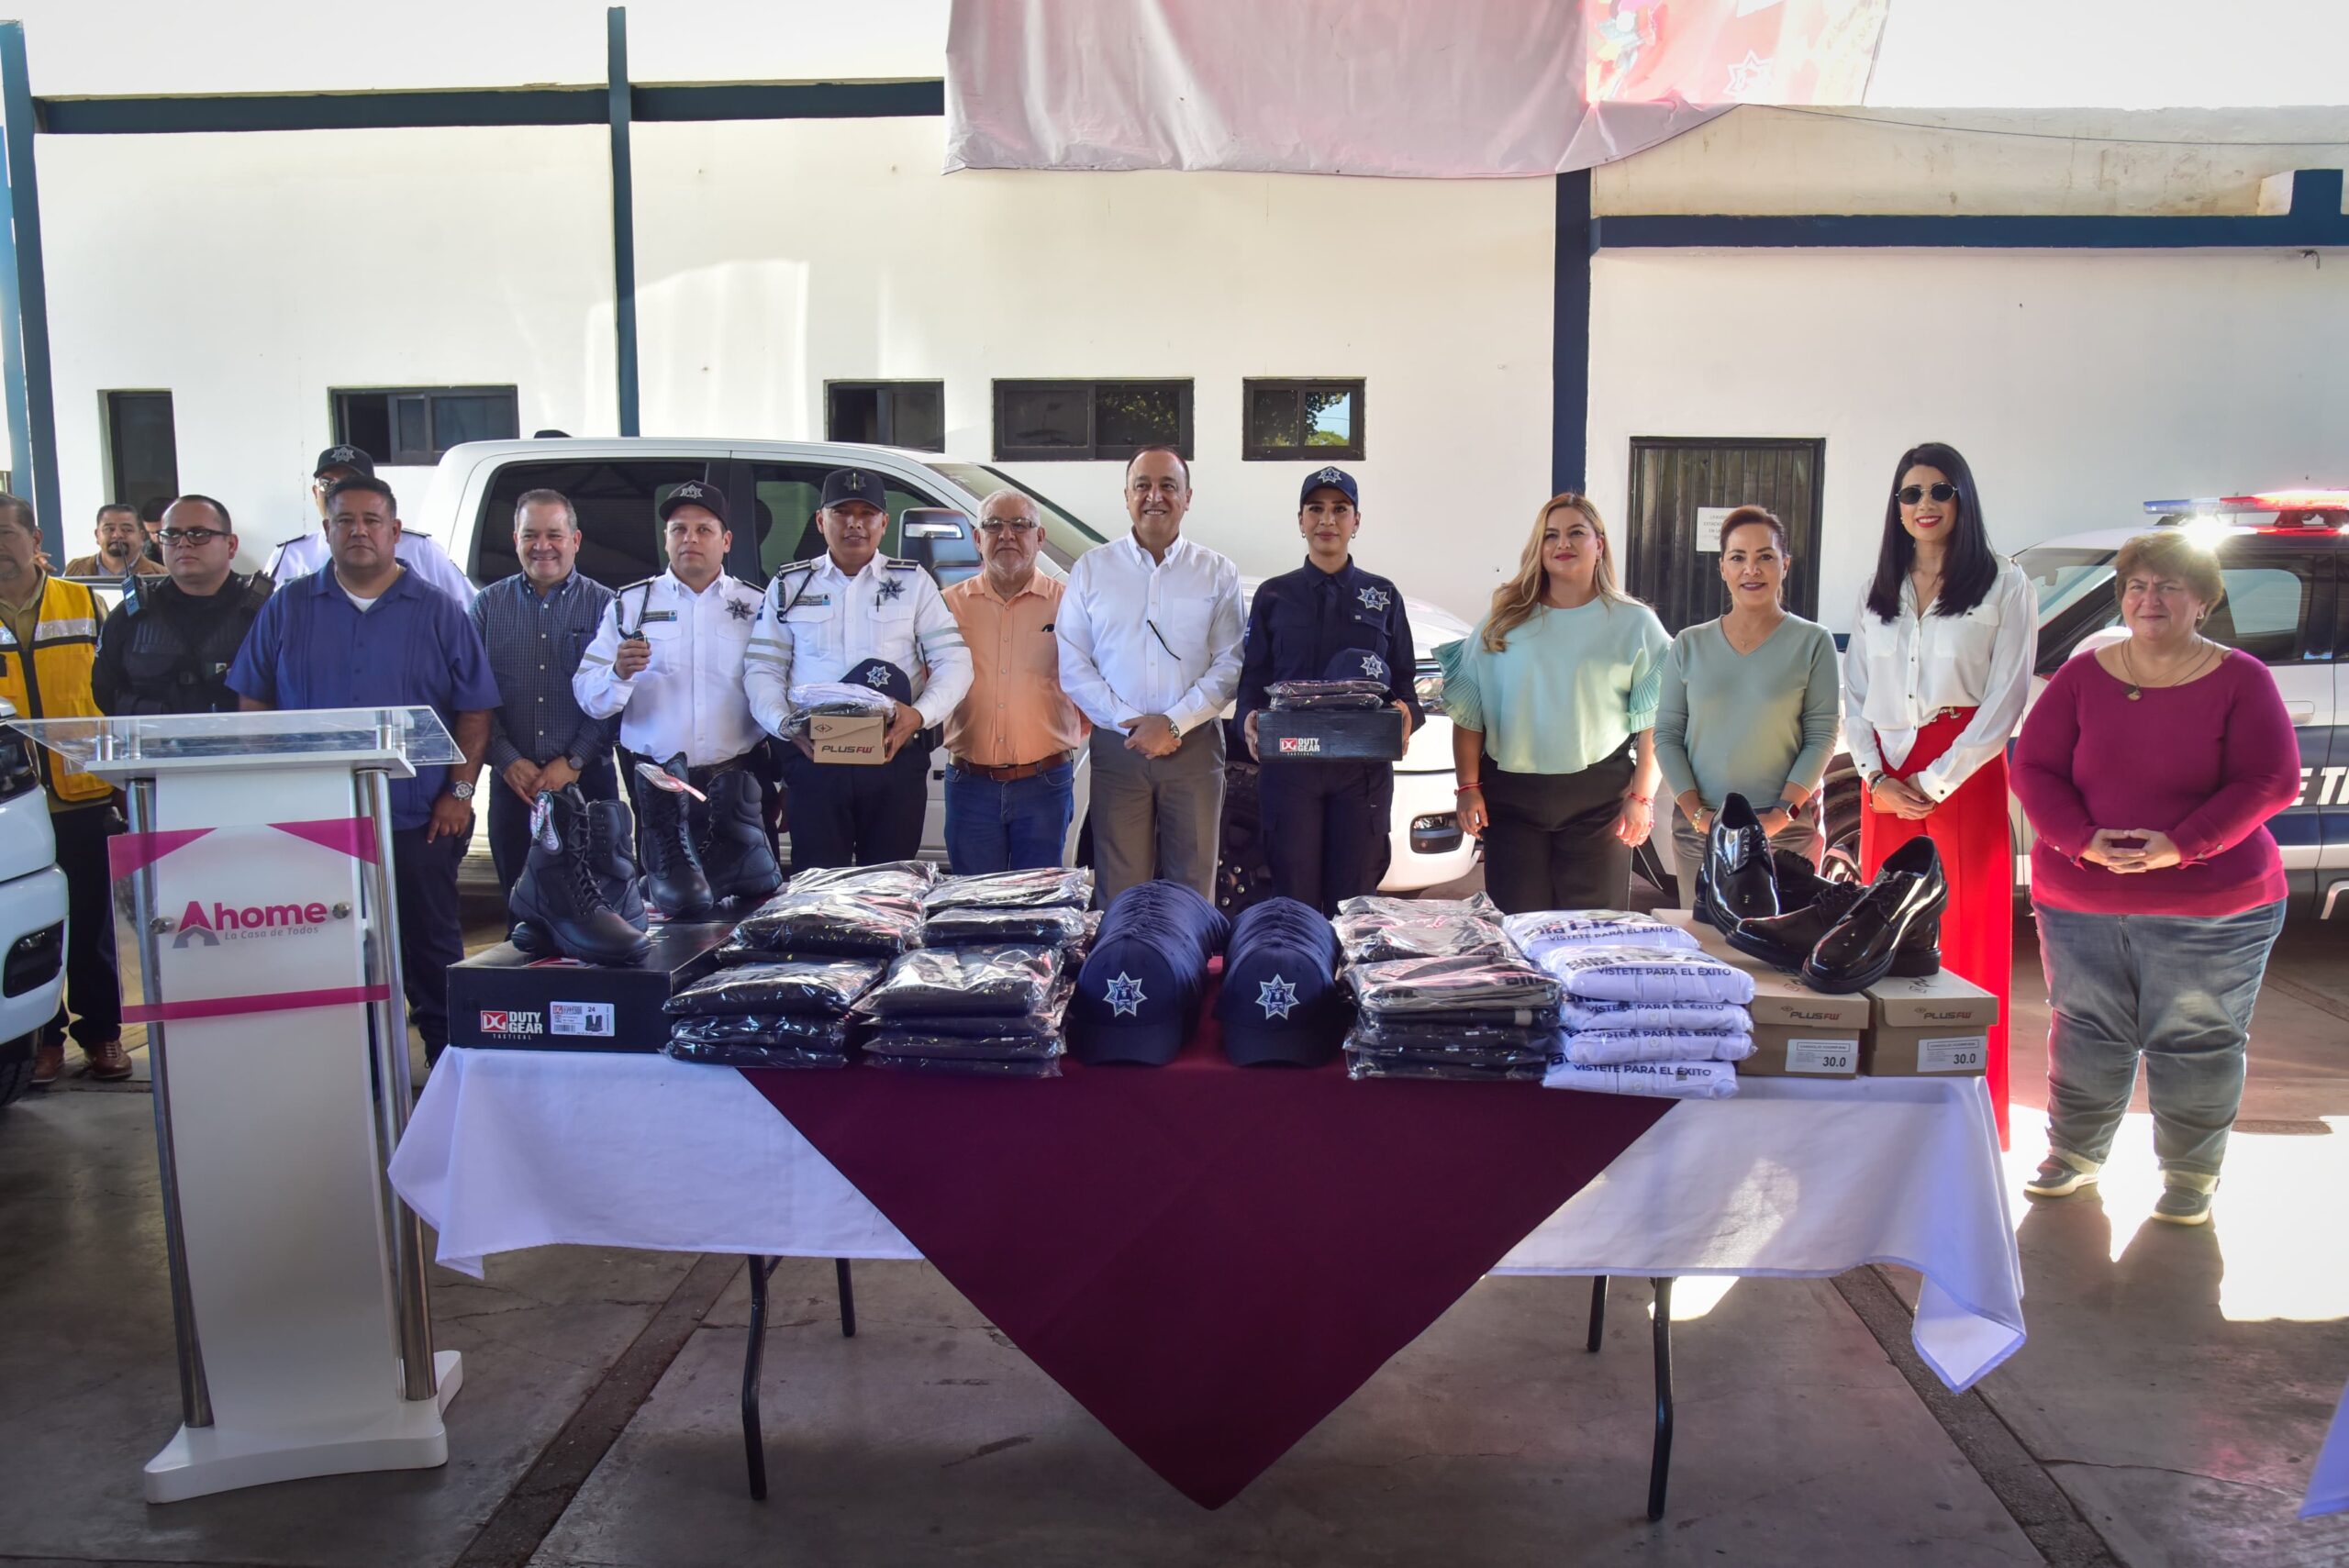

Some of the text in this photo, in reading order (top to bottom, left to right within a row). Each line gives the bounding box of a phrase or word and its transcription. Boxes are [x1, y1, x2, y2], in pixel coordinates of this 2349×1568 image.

[1298, 744, 1320, 752] GEAR
[177, 900, 328, 932] Ahome
[225, 926, 319, 940] La Casa de Todos
[1646, 968, 1678, 976] PARA
[1681, 968, 1696, 976] EL
[1698, 966, 1732, 976] ÉXITO
[509, 1011, 541, 1023] DUTY
[508, 1022, 543, 1034] GEAR
[1822, 1057, 1846, 1067] 30.0
[1953, 1053, 1976, 1064] 30.0
[1624, 1065, 1657, 1074] PARA
[1660, 1067, 1675, 1075] EL
